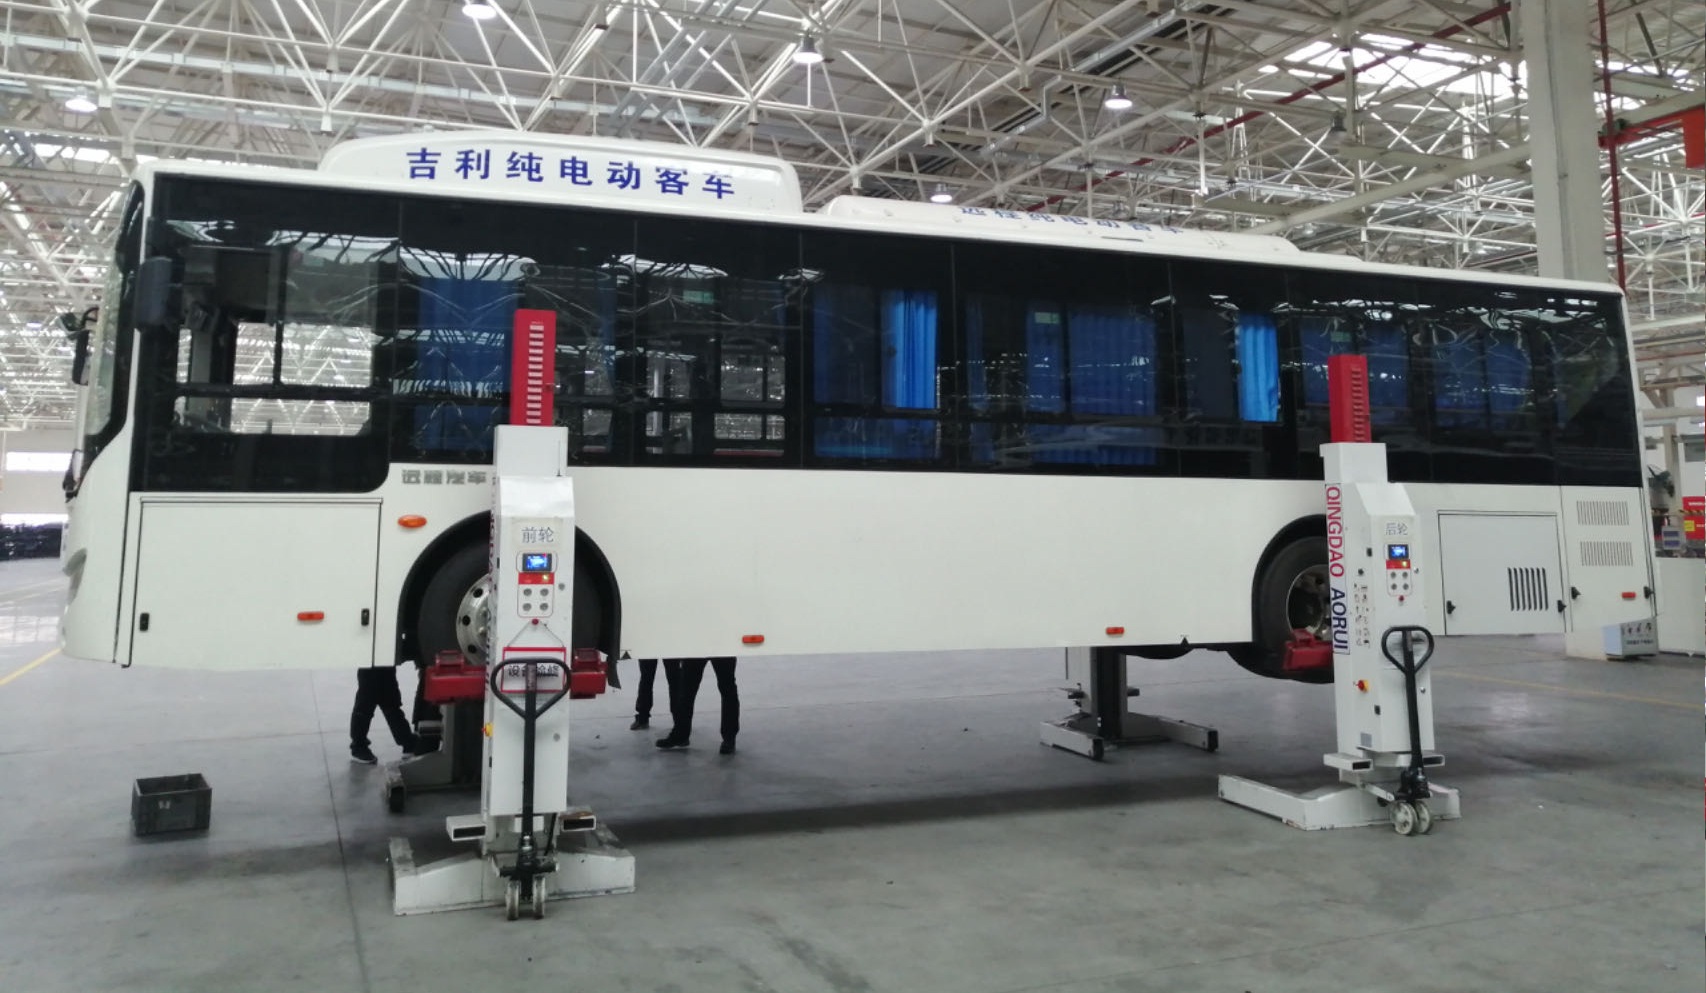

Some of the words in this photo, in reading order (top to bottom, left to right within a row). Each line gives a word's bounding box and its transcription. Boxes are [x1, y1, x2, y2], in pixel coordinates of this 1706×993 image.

[405, 147, 735, 199] 吉利纯电动客车
[521, 526, 554, 543] 前轮
[1325, 486, 1344, 577] QINGDAO
[1385, 522, 1408, 536] 后轮
[1331, 587, 1348, 650] AORUI
